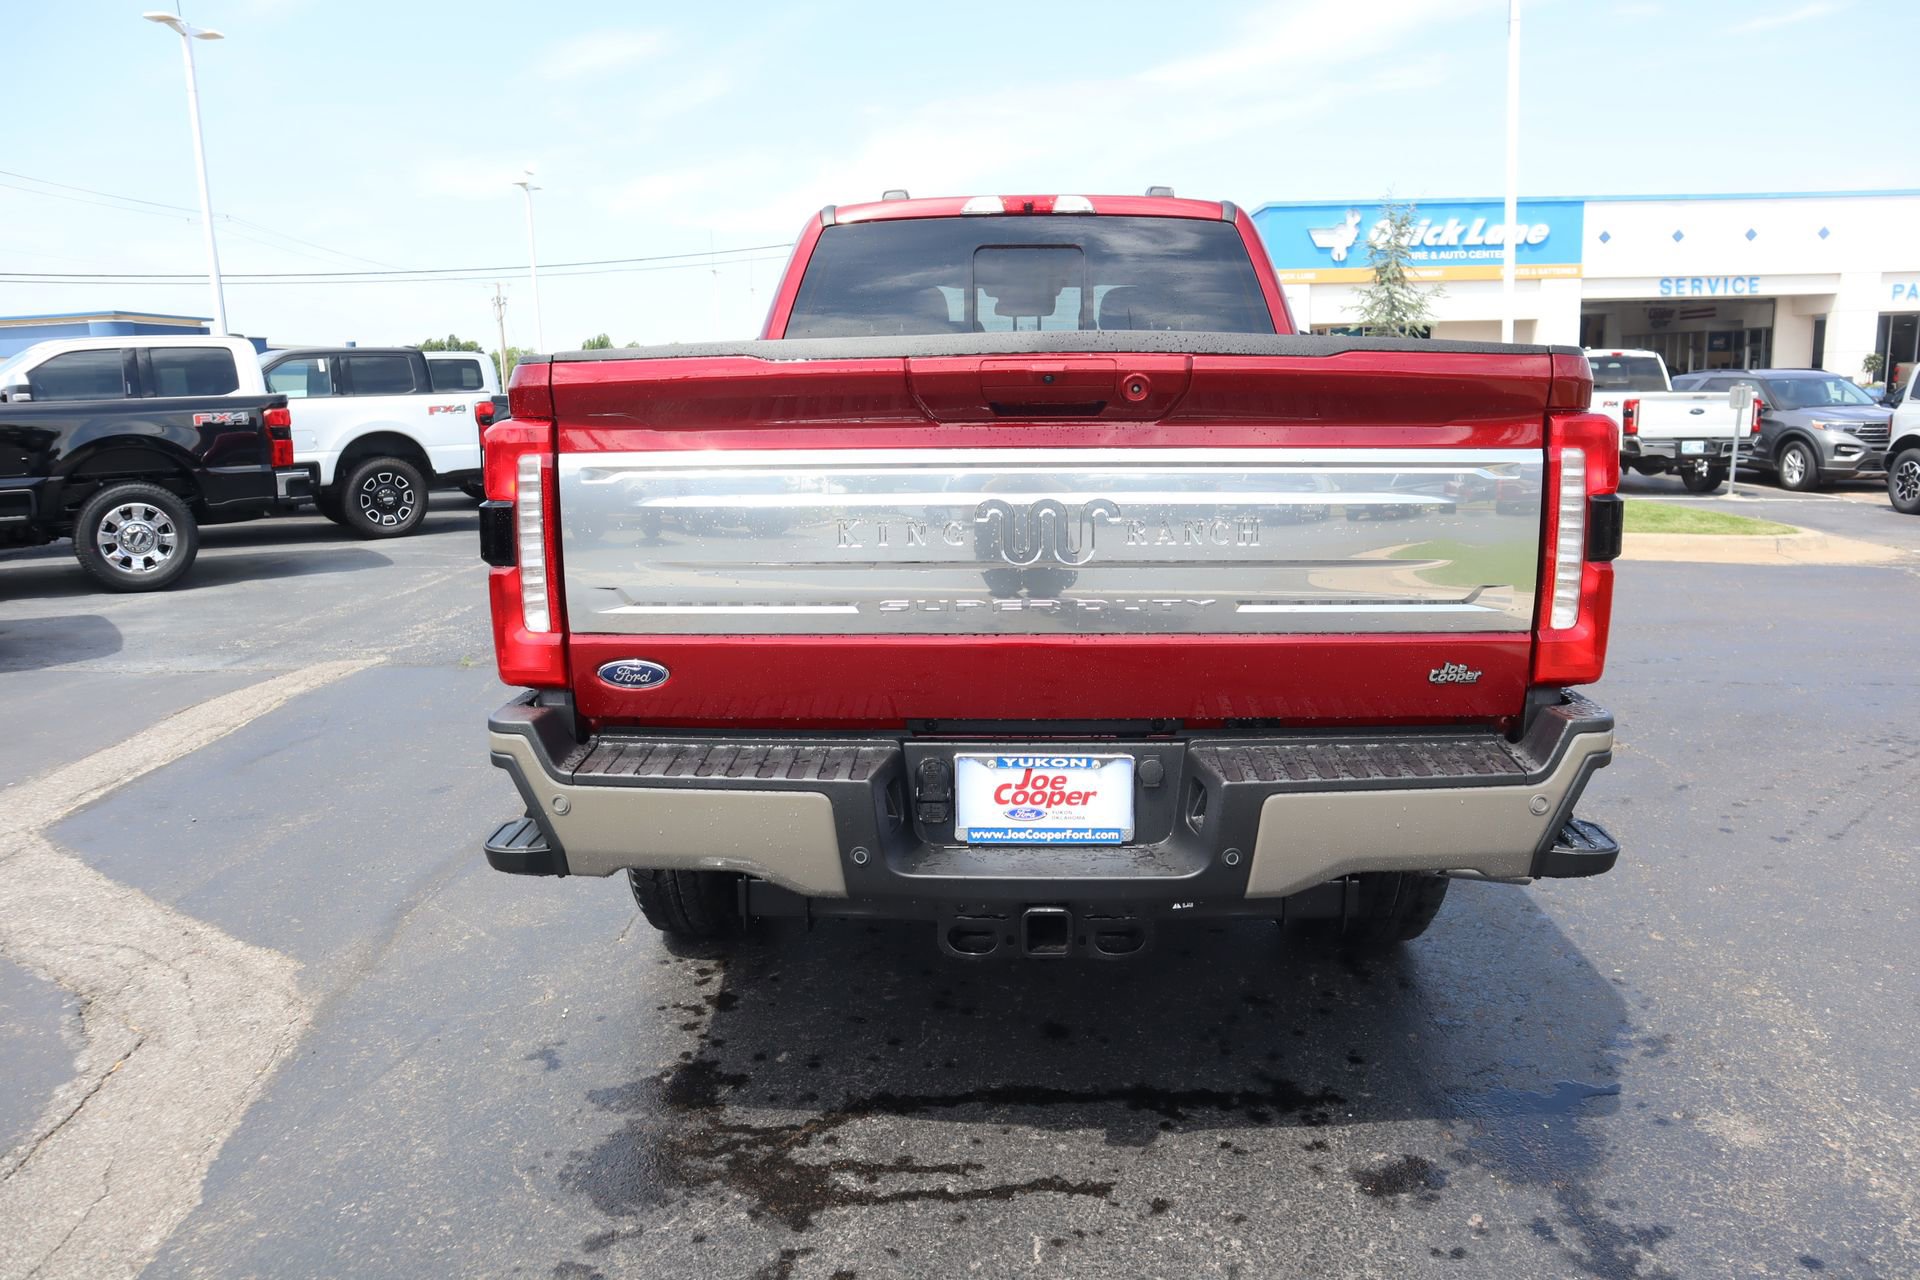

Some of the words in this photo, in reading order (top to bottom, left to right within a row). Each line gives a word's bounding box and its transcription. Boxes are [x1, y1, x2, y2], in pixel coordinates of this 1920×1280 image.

[1368, 217, 1467, 250] Quick
[1463, 217, 1550, 246] Lane
[1406, 252, 1428, 260] IRE
[1430, 252, 1439, 260] &
[1440, 251, 1467, 260] AUTO
[1468, 250, 1505, 259] CENTE
[1660, 276, 1760, 295] SERVICE
[1892, 283, 1920, 300] PA
[428, 404, 466, 415] FX4
[193, 411, 249, 426] FX4
[837, 518, 964, 548] KING
[1127, 515, 1262, 547] RANCH
[879, 599, 1061, 614] SUPER
[1076, 599, 1216, 614] DUTY
[613, 665, 652, 682] Ford
[1429, 669, 1482, 682] Cooper
[1440, 662, 1468, 674] Joe
[1003, 758, 1087, 767] YUKON
[1014, 768, 1067, 790] Joe
[994, 783, 1098, 808] Cooper
[1014, 807, 1037, 818] Ford
[970, 829, 1119, 841] www.JoeCooperFord.com
